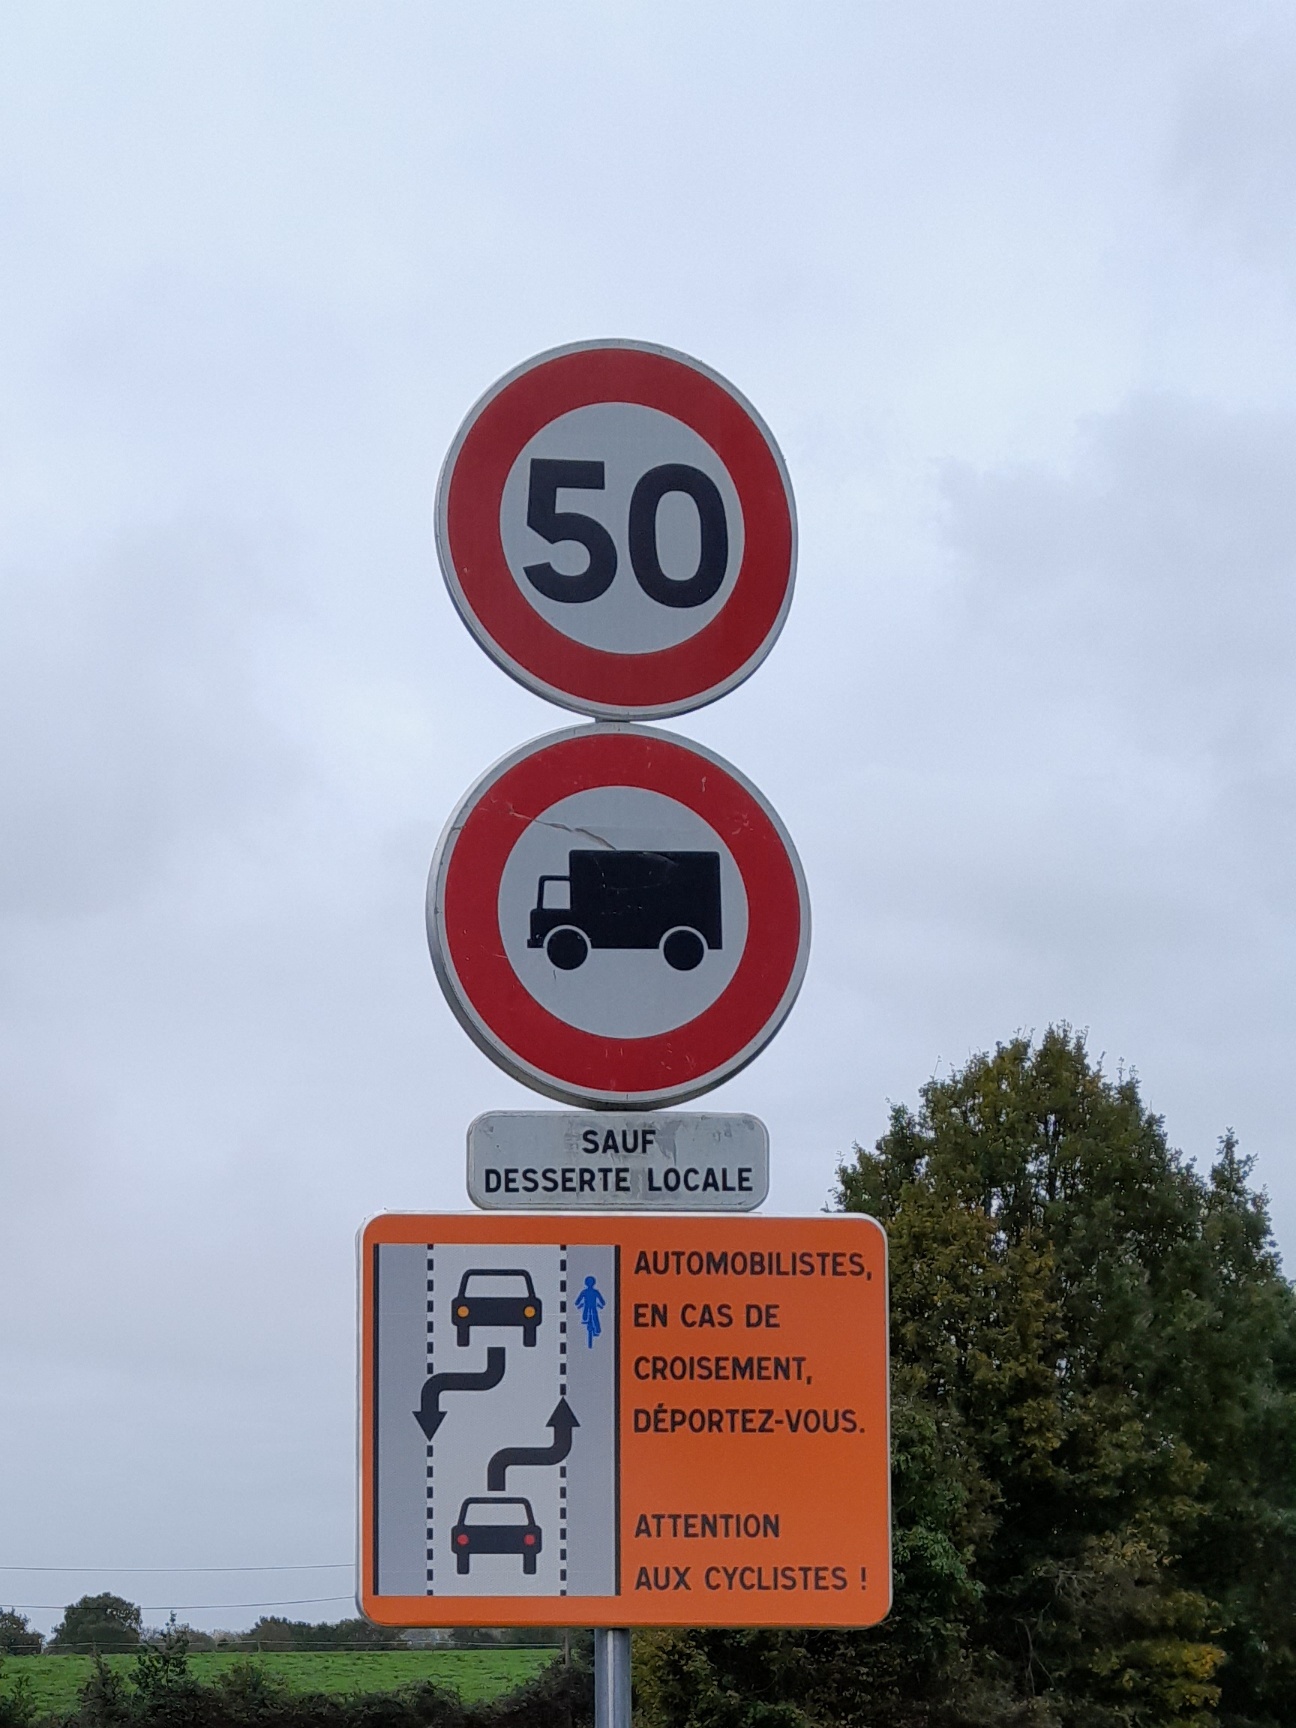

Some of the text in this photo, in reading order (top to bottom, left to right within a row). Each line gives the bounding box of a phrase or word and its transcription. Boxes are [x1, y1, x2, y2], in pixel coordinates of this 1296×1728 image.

[523, 458, 729, 608] 50
[581, 1129, 656, 1154] SAUF
[484, 1167, 753, 1193] DESSERTE LOCALE
[634, 1250, 872, 1281] AUTOMOBILISTES,
[633, 1303, 780, 1328] EN CAS DE
[634, 1356, 812, 1385] CROISEMENT,
[633, 1403, 865, 1433] DÉPORTEZ-VOUS.
[634, 1513, 780, 1538] ATTENTION
[634, 1566, 692, 1591] AUX
[704, 1566, 848, 1591] CYCLISTES
